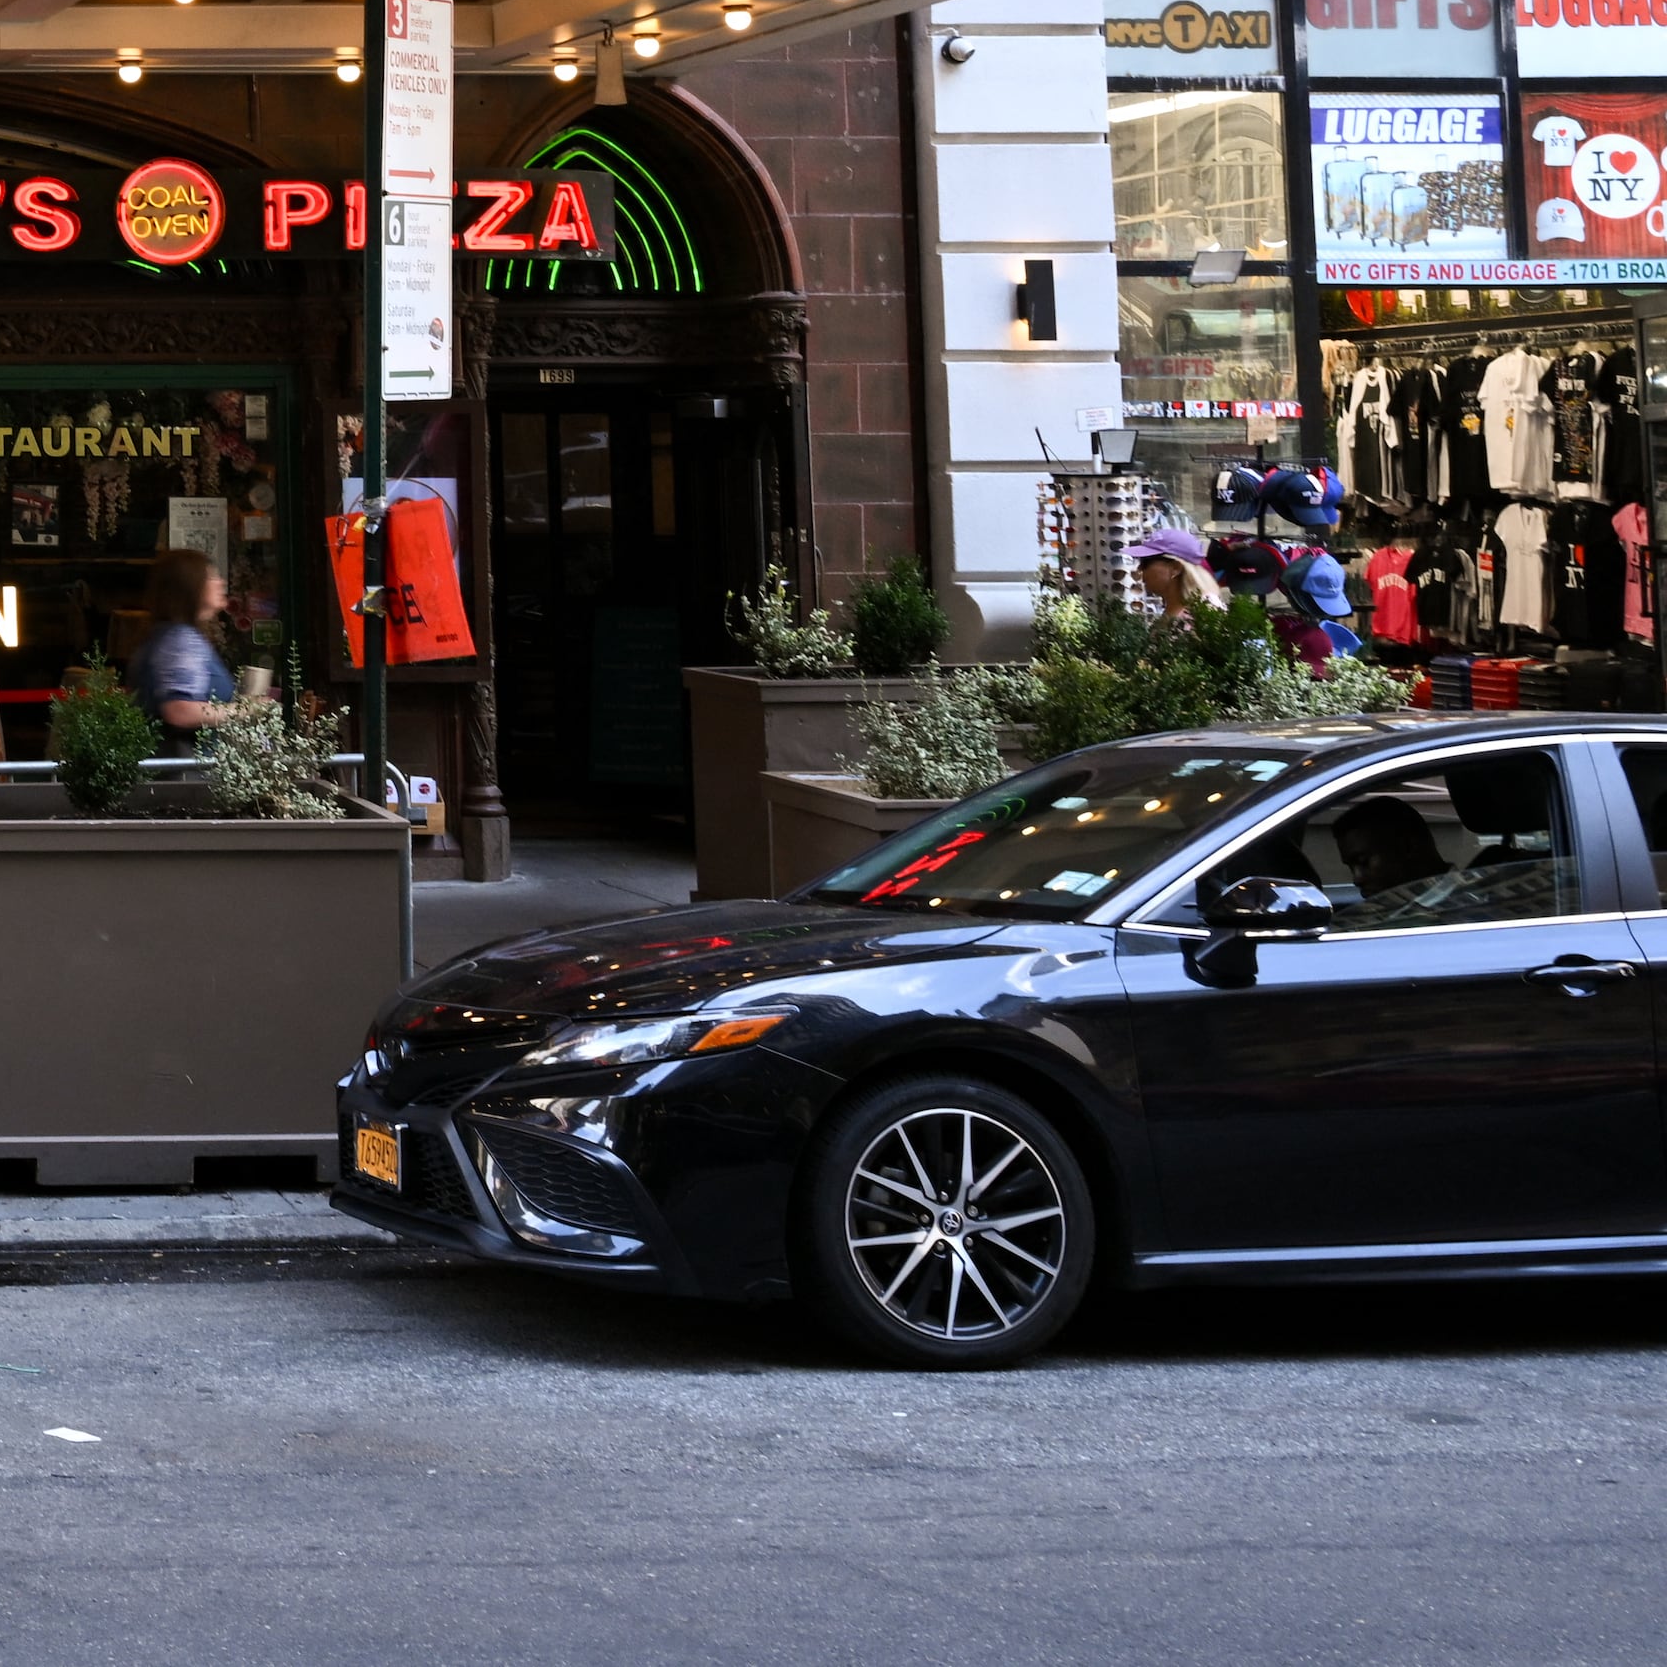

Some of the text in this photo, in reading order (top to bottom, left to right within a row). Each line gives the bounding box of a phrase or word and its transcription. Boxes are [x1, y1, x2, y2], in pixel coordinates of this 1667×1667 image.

[1105, 7, 1270, 48] NYC TAXI
[390, 50, 440, 73] COMMERCIAL
[390, 73, 448, 96] VEHICLES ONLY
[389, 102, 411, 121] Monday
[417, 104, 435, 123] Friday
[1324, 108, 1485, 144] LUGGAGE
[1592, 151, 1606, 174] I
[127, 184, 210, 210] COAL
[1588, 178, 1644, 201] NY
[131, 212, 209, 239] OVEN
[264, 178, 602, 252] PIZA
[388, 204, 402, 244] 6
[387, 257, 412, 274] Monday
[417, 258, 436, 276] Friday
[1325, 263, 1361, 280] NYC
[1367, 263, 1420, 281] GIFTS
[1427, 263, 1464, 280] AND
[1471, 263, 1557, 280] LUGGAGE
[406, 278, 431, 294] Midnight
[387, 302, 416, 319] Saturday
[1161, 357, 1215, 376] GIFTS
